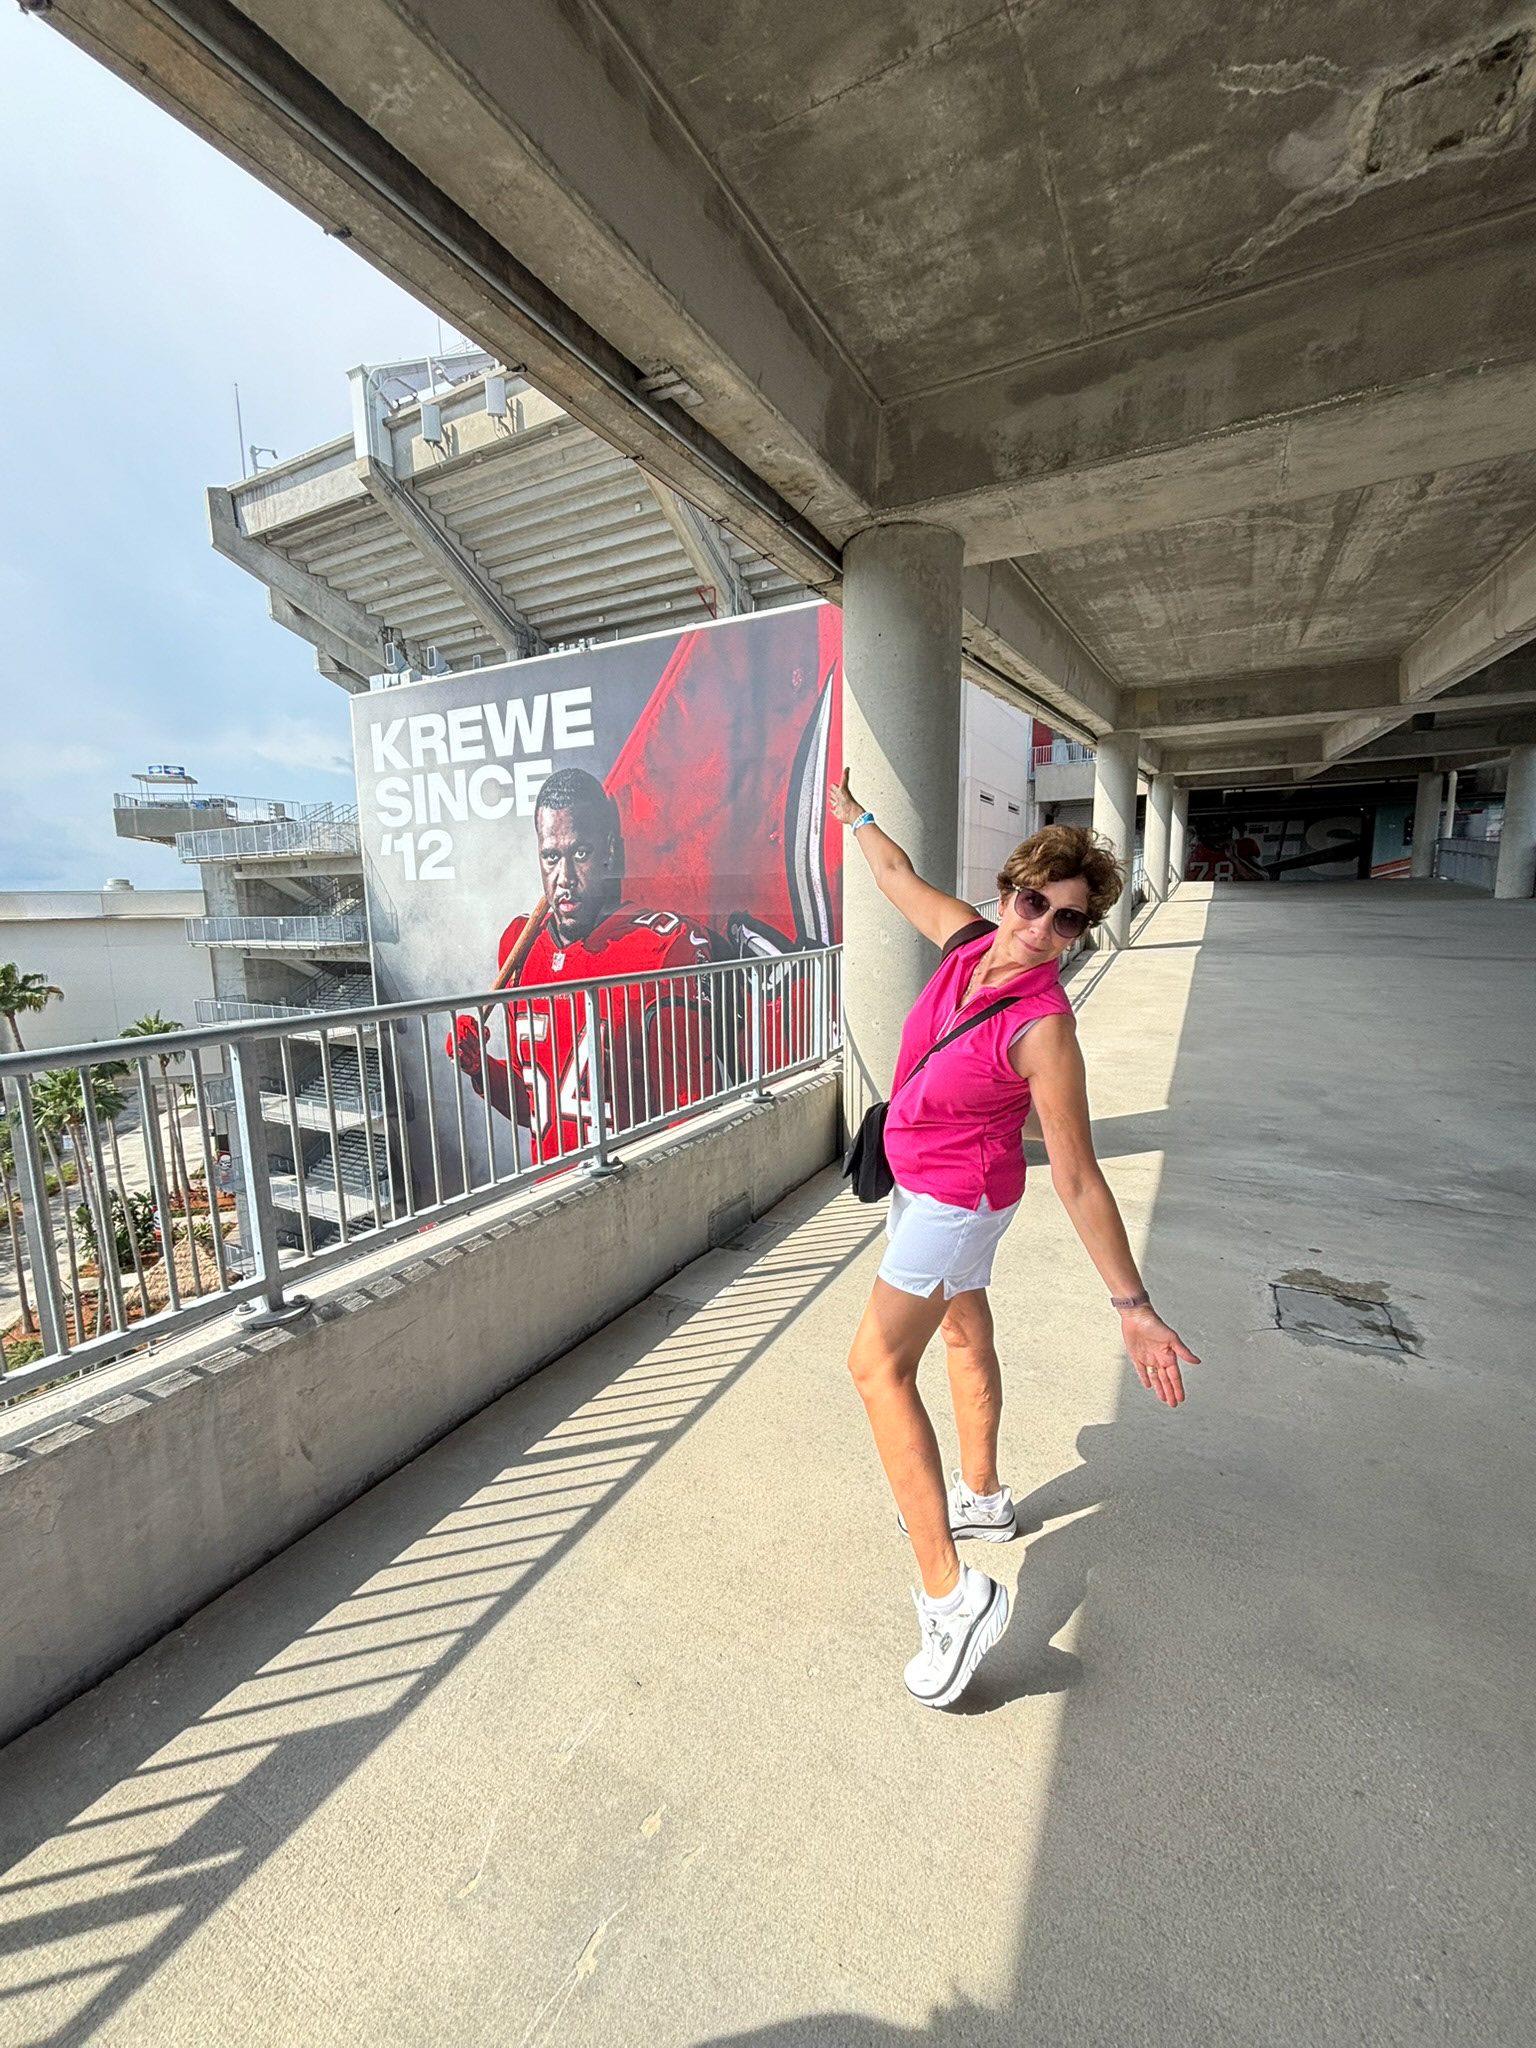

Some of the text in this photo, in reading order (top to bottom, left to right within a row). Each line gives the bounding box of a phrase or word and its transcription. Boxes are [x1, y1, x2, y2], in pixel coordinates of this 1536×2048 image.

[370, 686, 595, 773] KREWE
[375, 758, 553, 828] SINCE
[1190, 861, 1235, 881] 78
